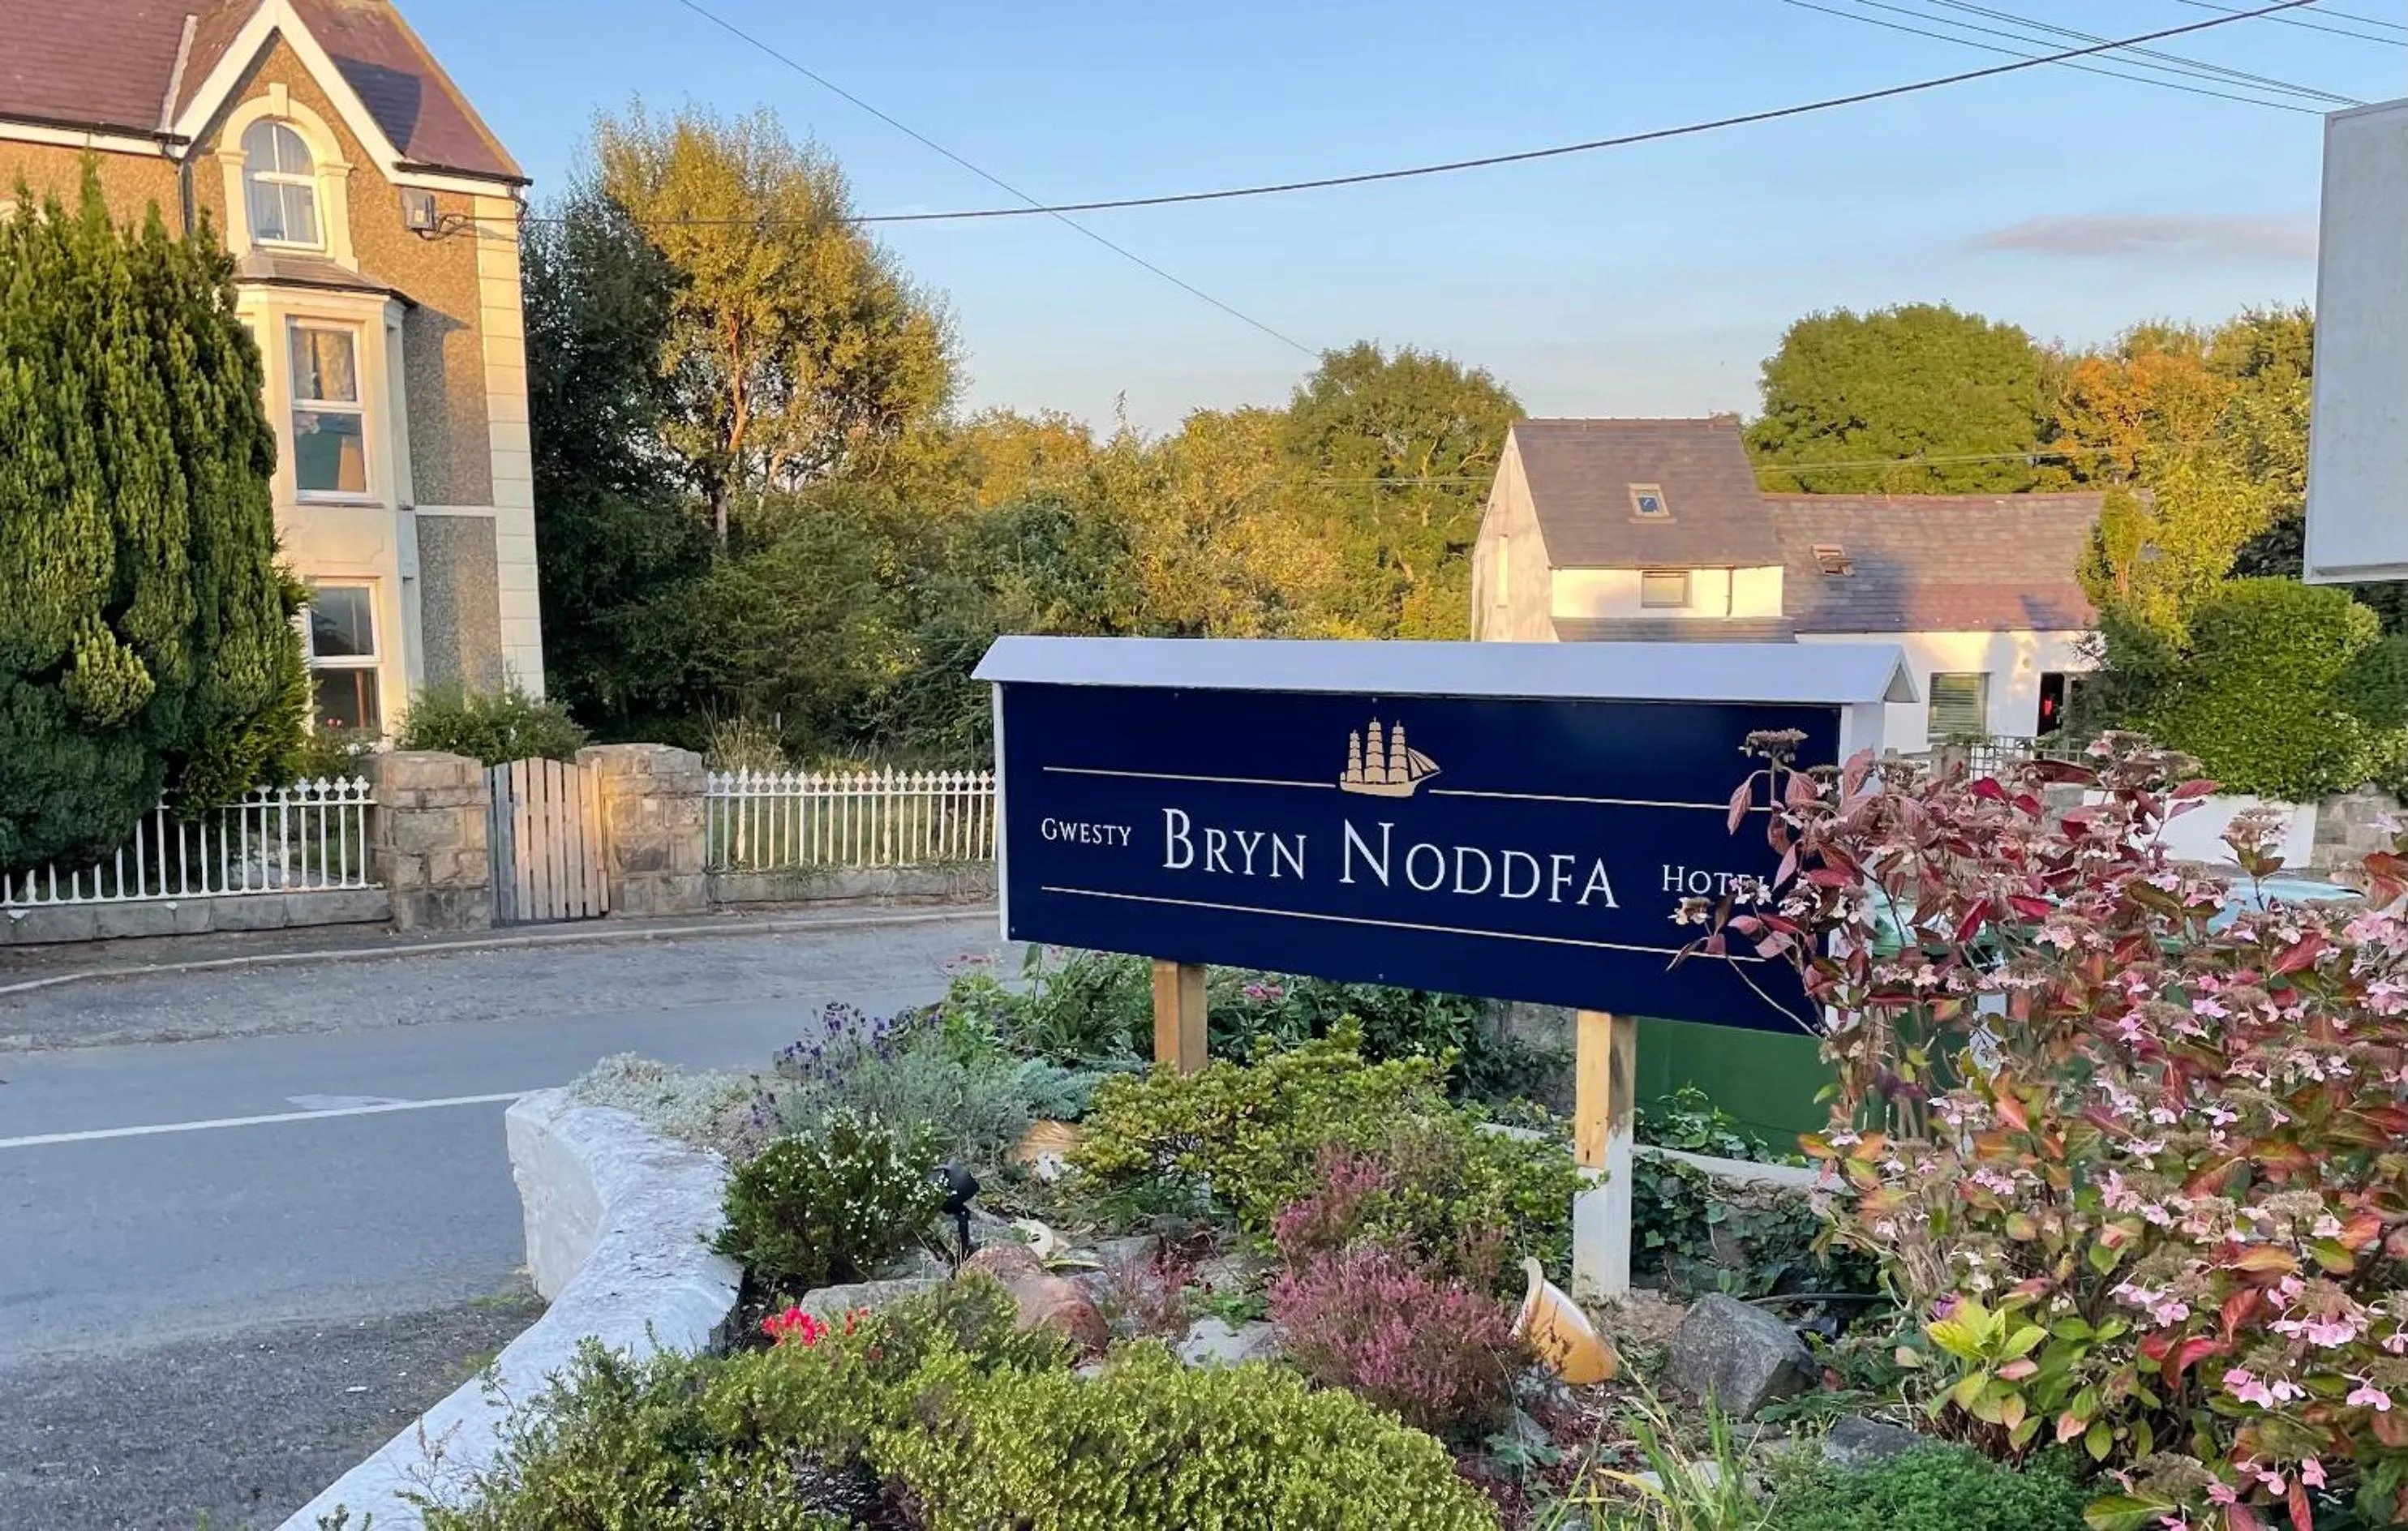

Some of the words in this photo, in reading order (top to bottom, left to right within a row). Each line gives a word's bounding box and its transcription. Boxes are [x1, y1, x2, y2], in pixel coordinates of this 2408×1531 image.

[1041, 817, 1131, 847] GWESTY
[1161, 808, 1306, 879] BRYN
[1339, 818, 1619, 907] NODDFA
